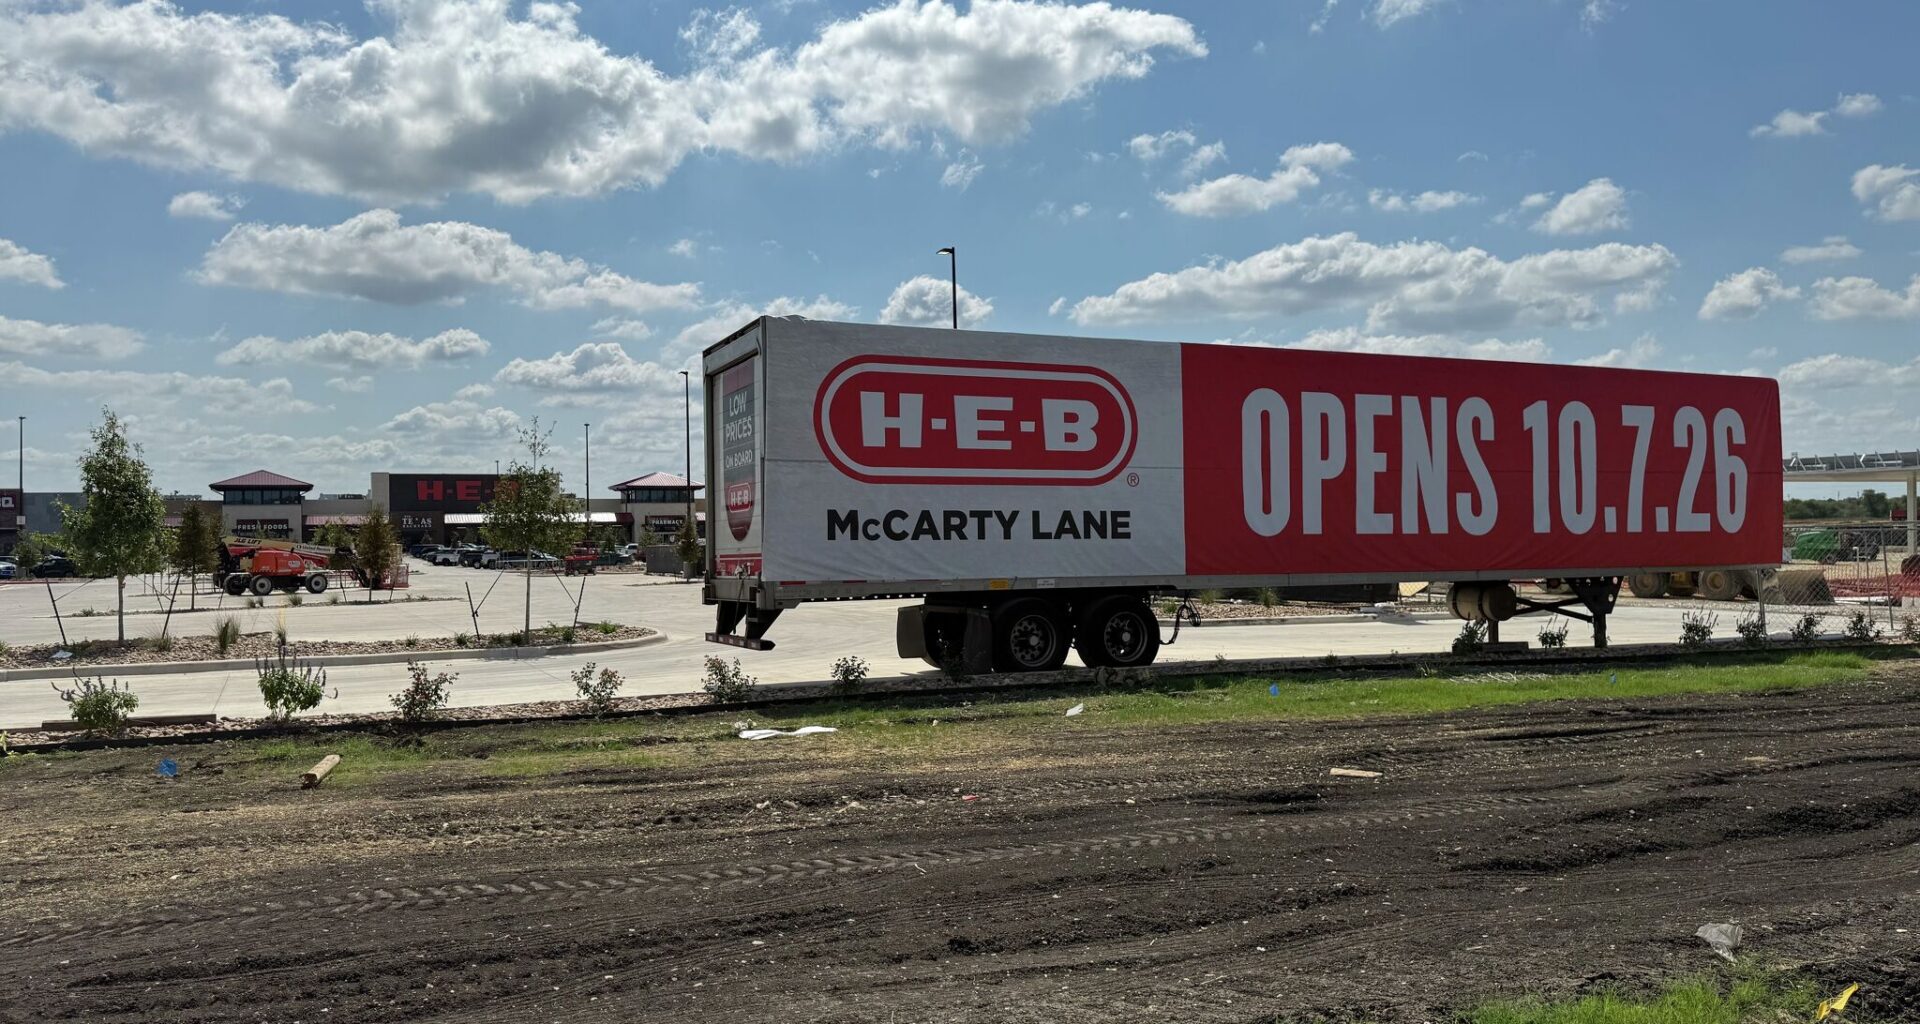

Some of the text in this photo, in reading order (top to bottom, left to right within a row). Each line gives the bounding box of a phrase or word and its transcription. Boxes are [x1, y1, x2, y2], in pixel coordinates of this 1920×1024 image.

[730, 391, 747, 417] LOW
[725, 416, 752, 444] PRICES
[860, 391, 1100, 452] H-E-B
[725, 449, 753, 468] ON BOARD
[1241, 388, 1748, 537] OPENS 10.7.26
[827, 509, 1132, 541] McCARTY LANE
